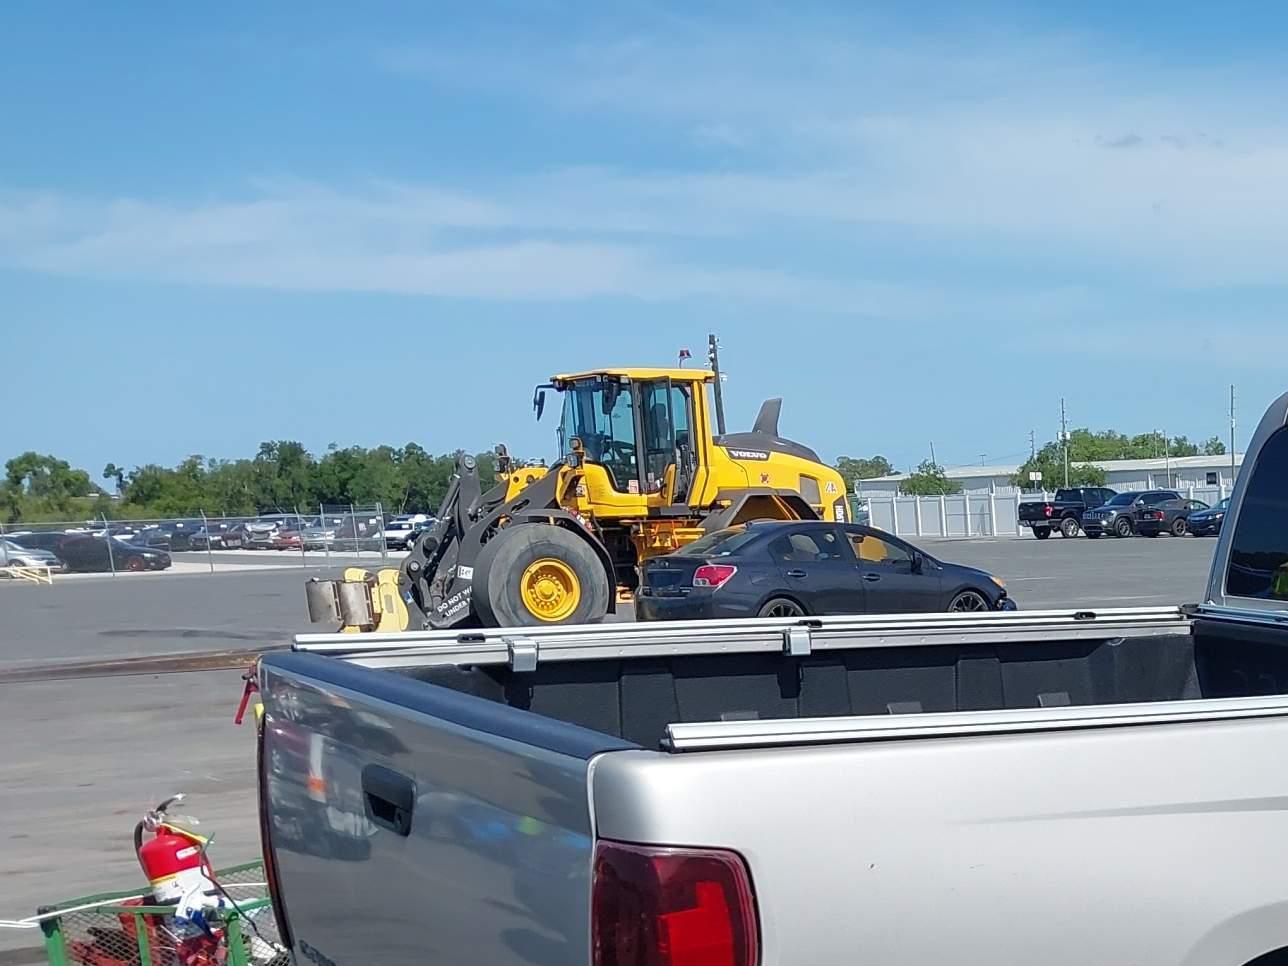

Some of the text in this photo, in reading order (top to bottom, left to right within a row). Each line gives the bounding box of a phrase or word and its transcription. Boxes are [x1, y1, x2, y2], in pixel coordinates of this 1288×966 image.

[729, 450, 768, 459] VOLVO
[437, 602, 448, 612] DO
[448, 592, 462, 605] NOT
[445, 600, 467, 617] UNDER
